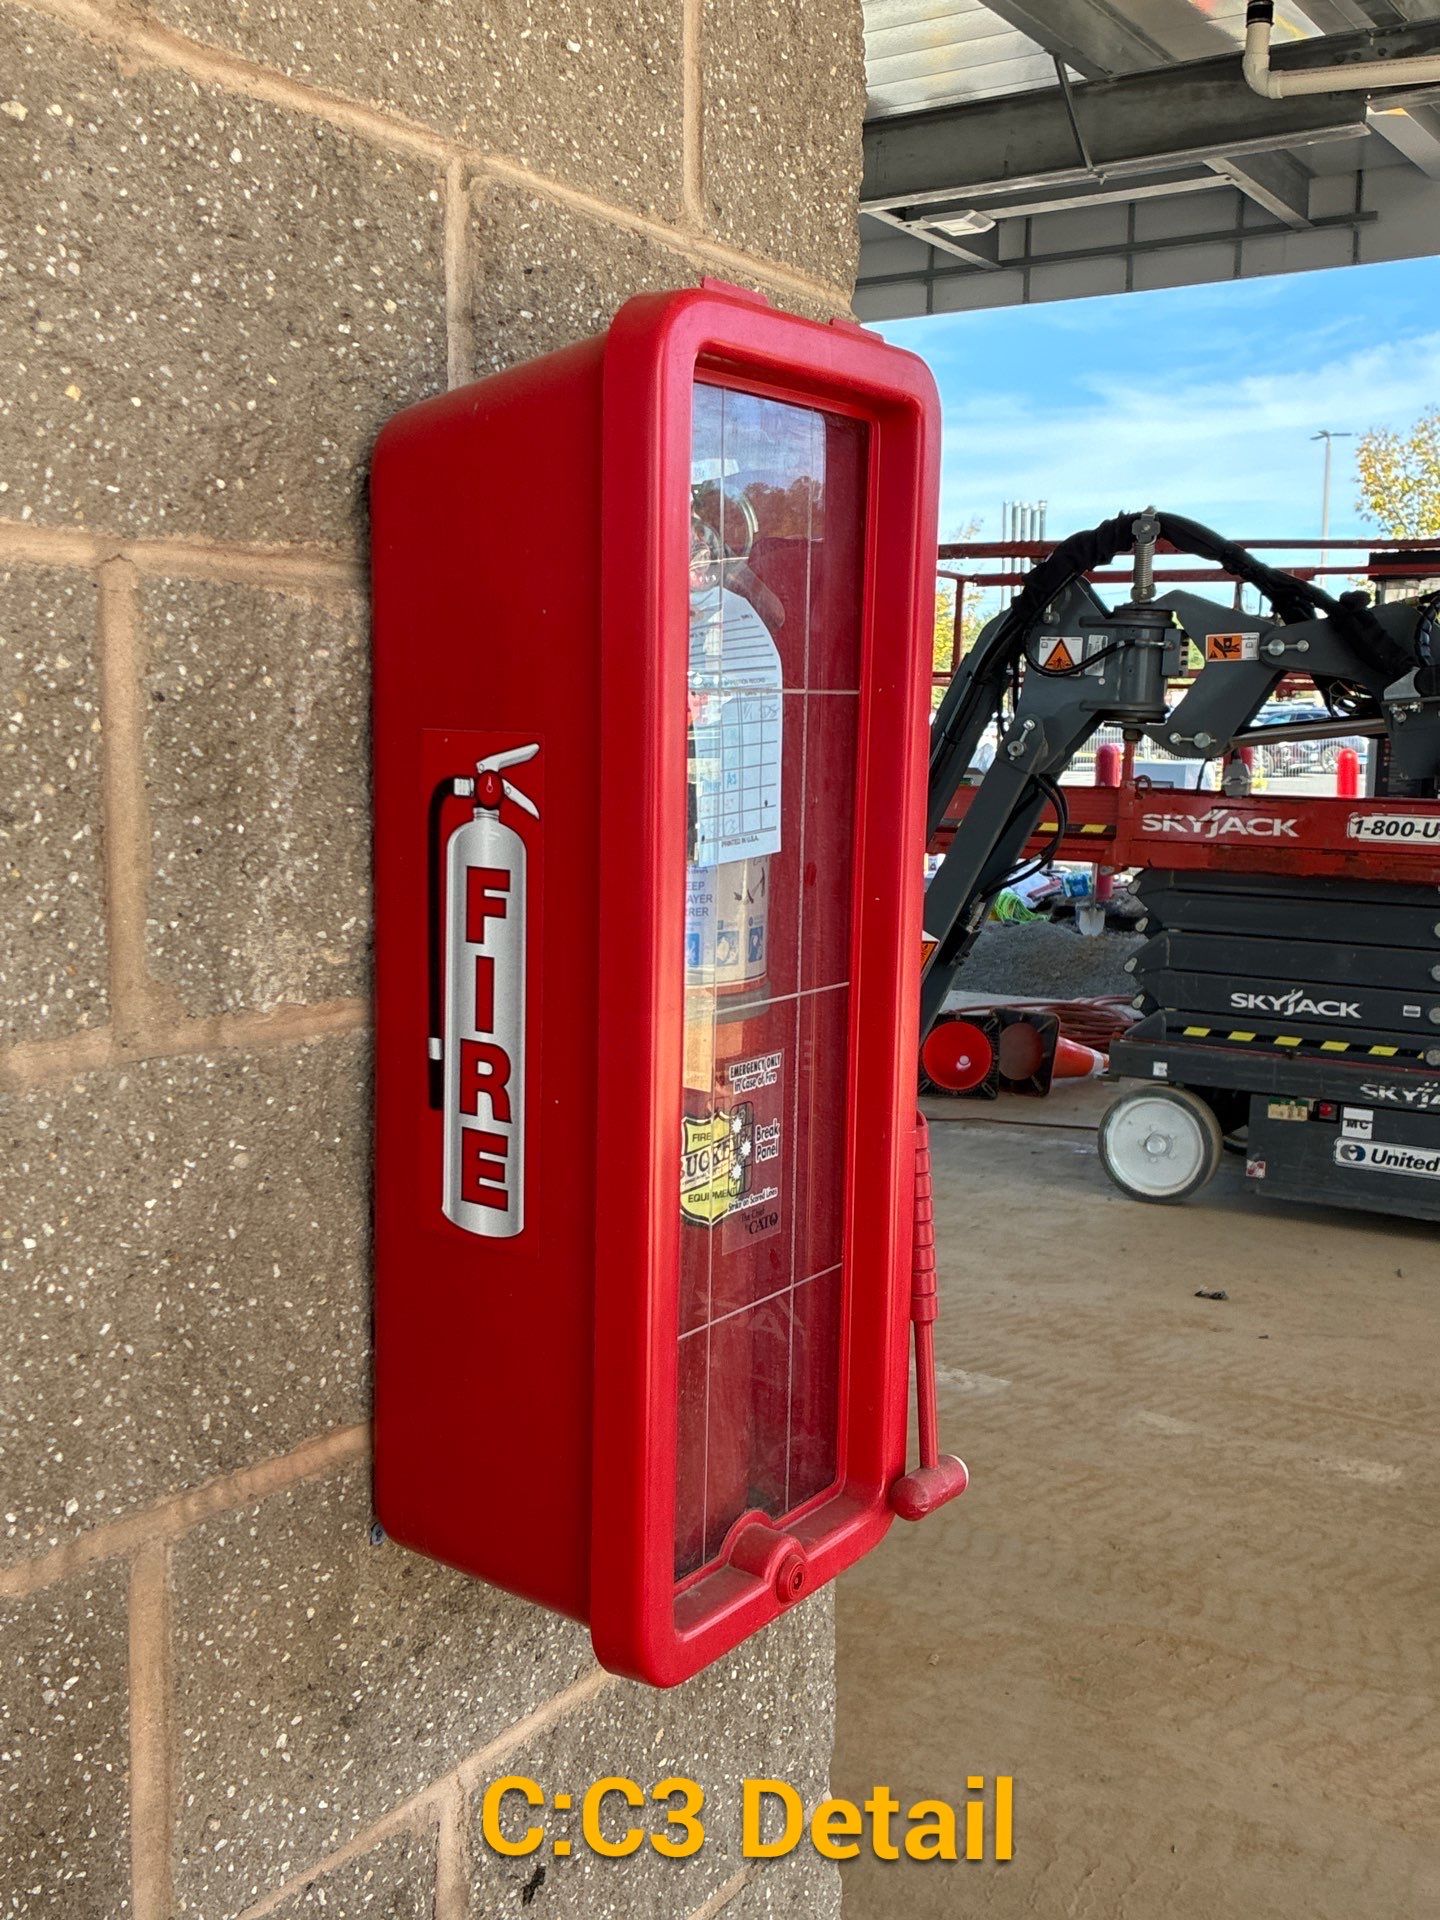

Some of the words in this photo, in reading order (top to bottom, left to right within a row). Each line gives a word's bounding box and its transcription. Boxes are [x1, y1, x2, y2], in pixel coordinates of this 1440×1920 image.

[1142, 809, 1300, 838] SKYJACK
[1354, 819, 1440, 839] 1-800-U
[1229, 989, 1362, 1019] SKYJACK
[459, 865, 513, 1212] FIRE
[730, 1058, 765, 1079] EMERGENCY
[766, 1055, 781, 1069] ONLY
[742, 1077, 756, 1090] Case
[765, 1071, 776, 1084] Fire
[692, 1132, 712, 1142] FIRE
[756, 1120, 779, 1141] Break
[756, 1142, 778, 1161] Panel
[1371, 1148, 1439, 1172] United
